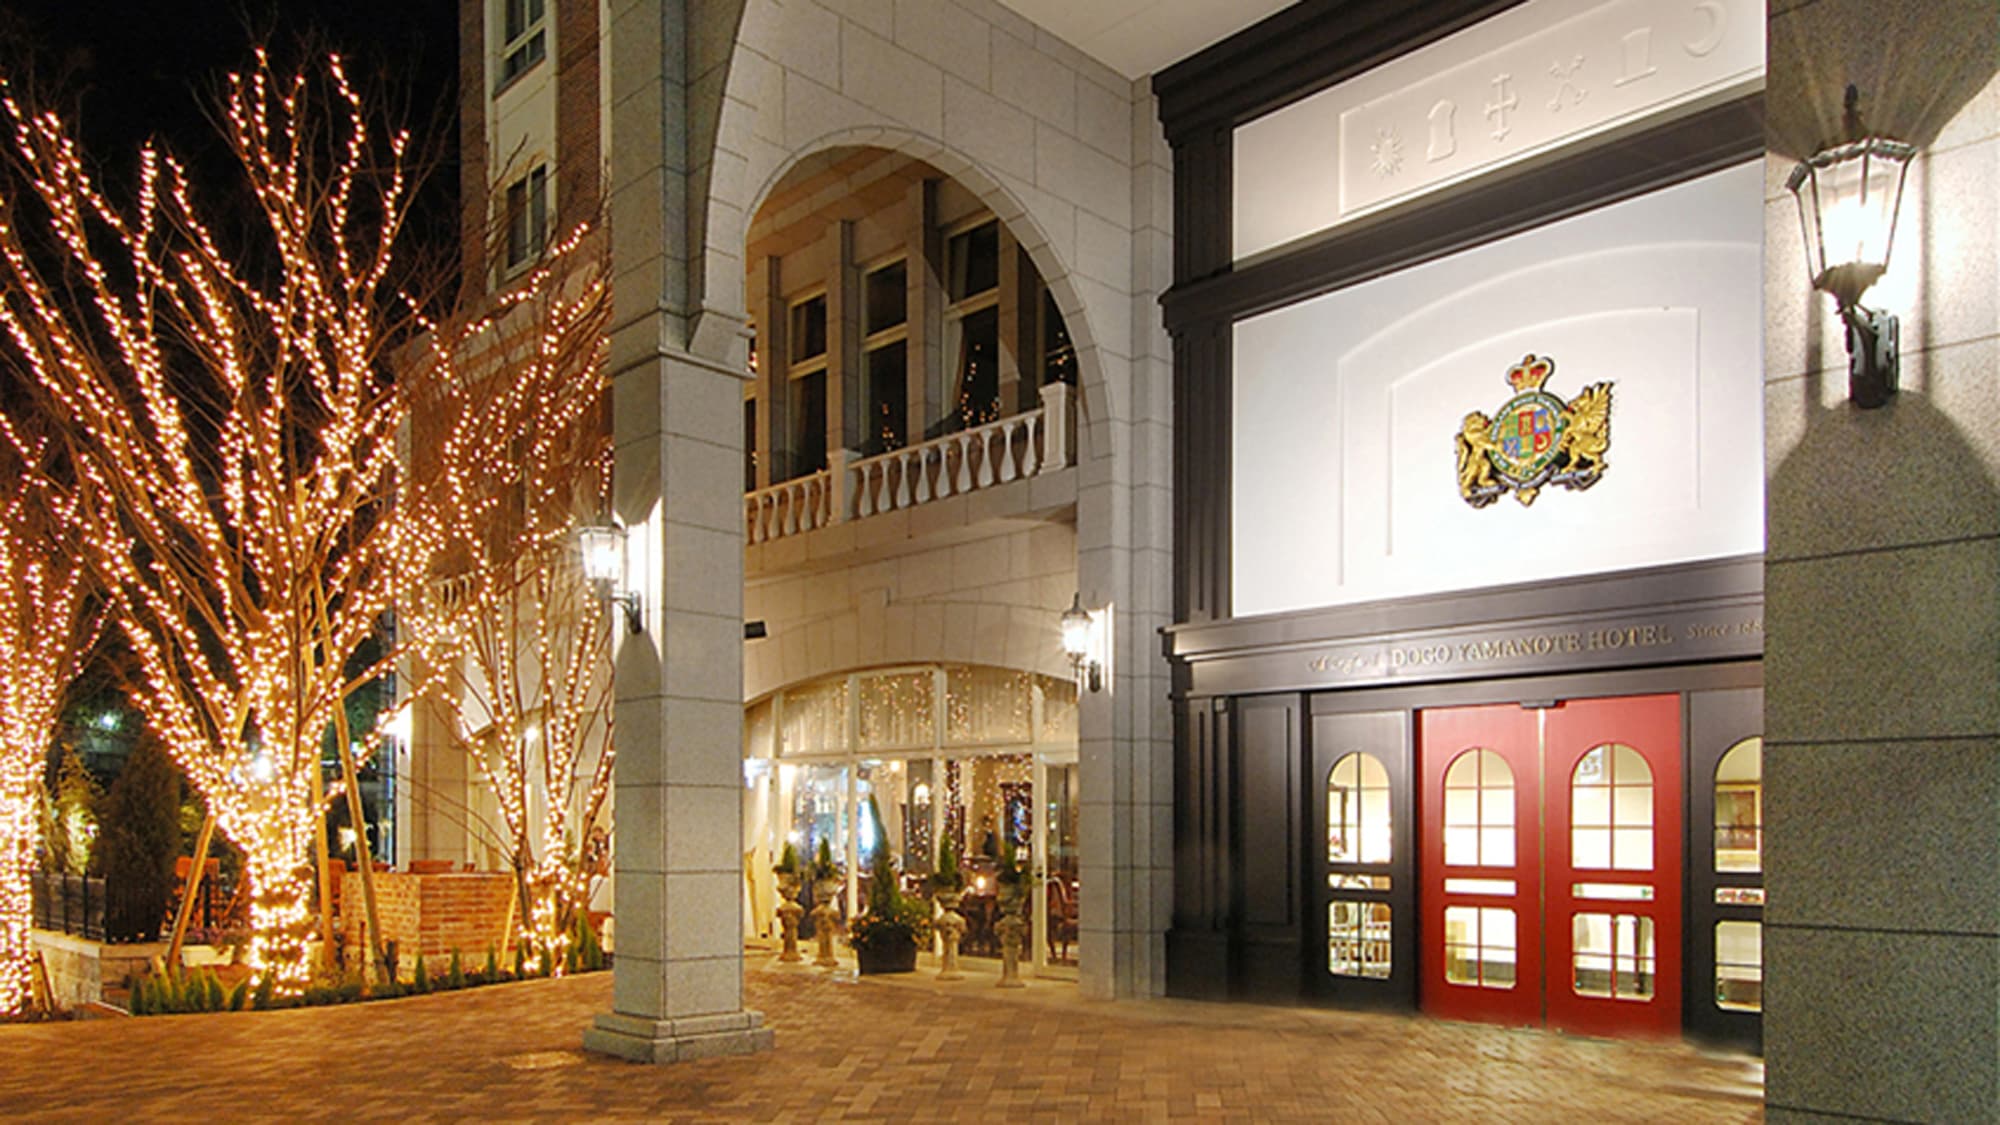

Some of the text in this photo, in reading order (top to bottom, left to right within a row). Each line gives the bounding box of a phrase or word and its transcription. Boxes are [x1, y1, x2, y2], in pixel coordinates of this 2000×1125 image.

[1391, 644, 1452, 668] DOGO
[1456, 632, 1584, 662] YAMANOTE
[1588, 623, 1674, 650] HOTEL
